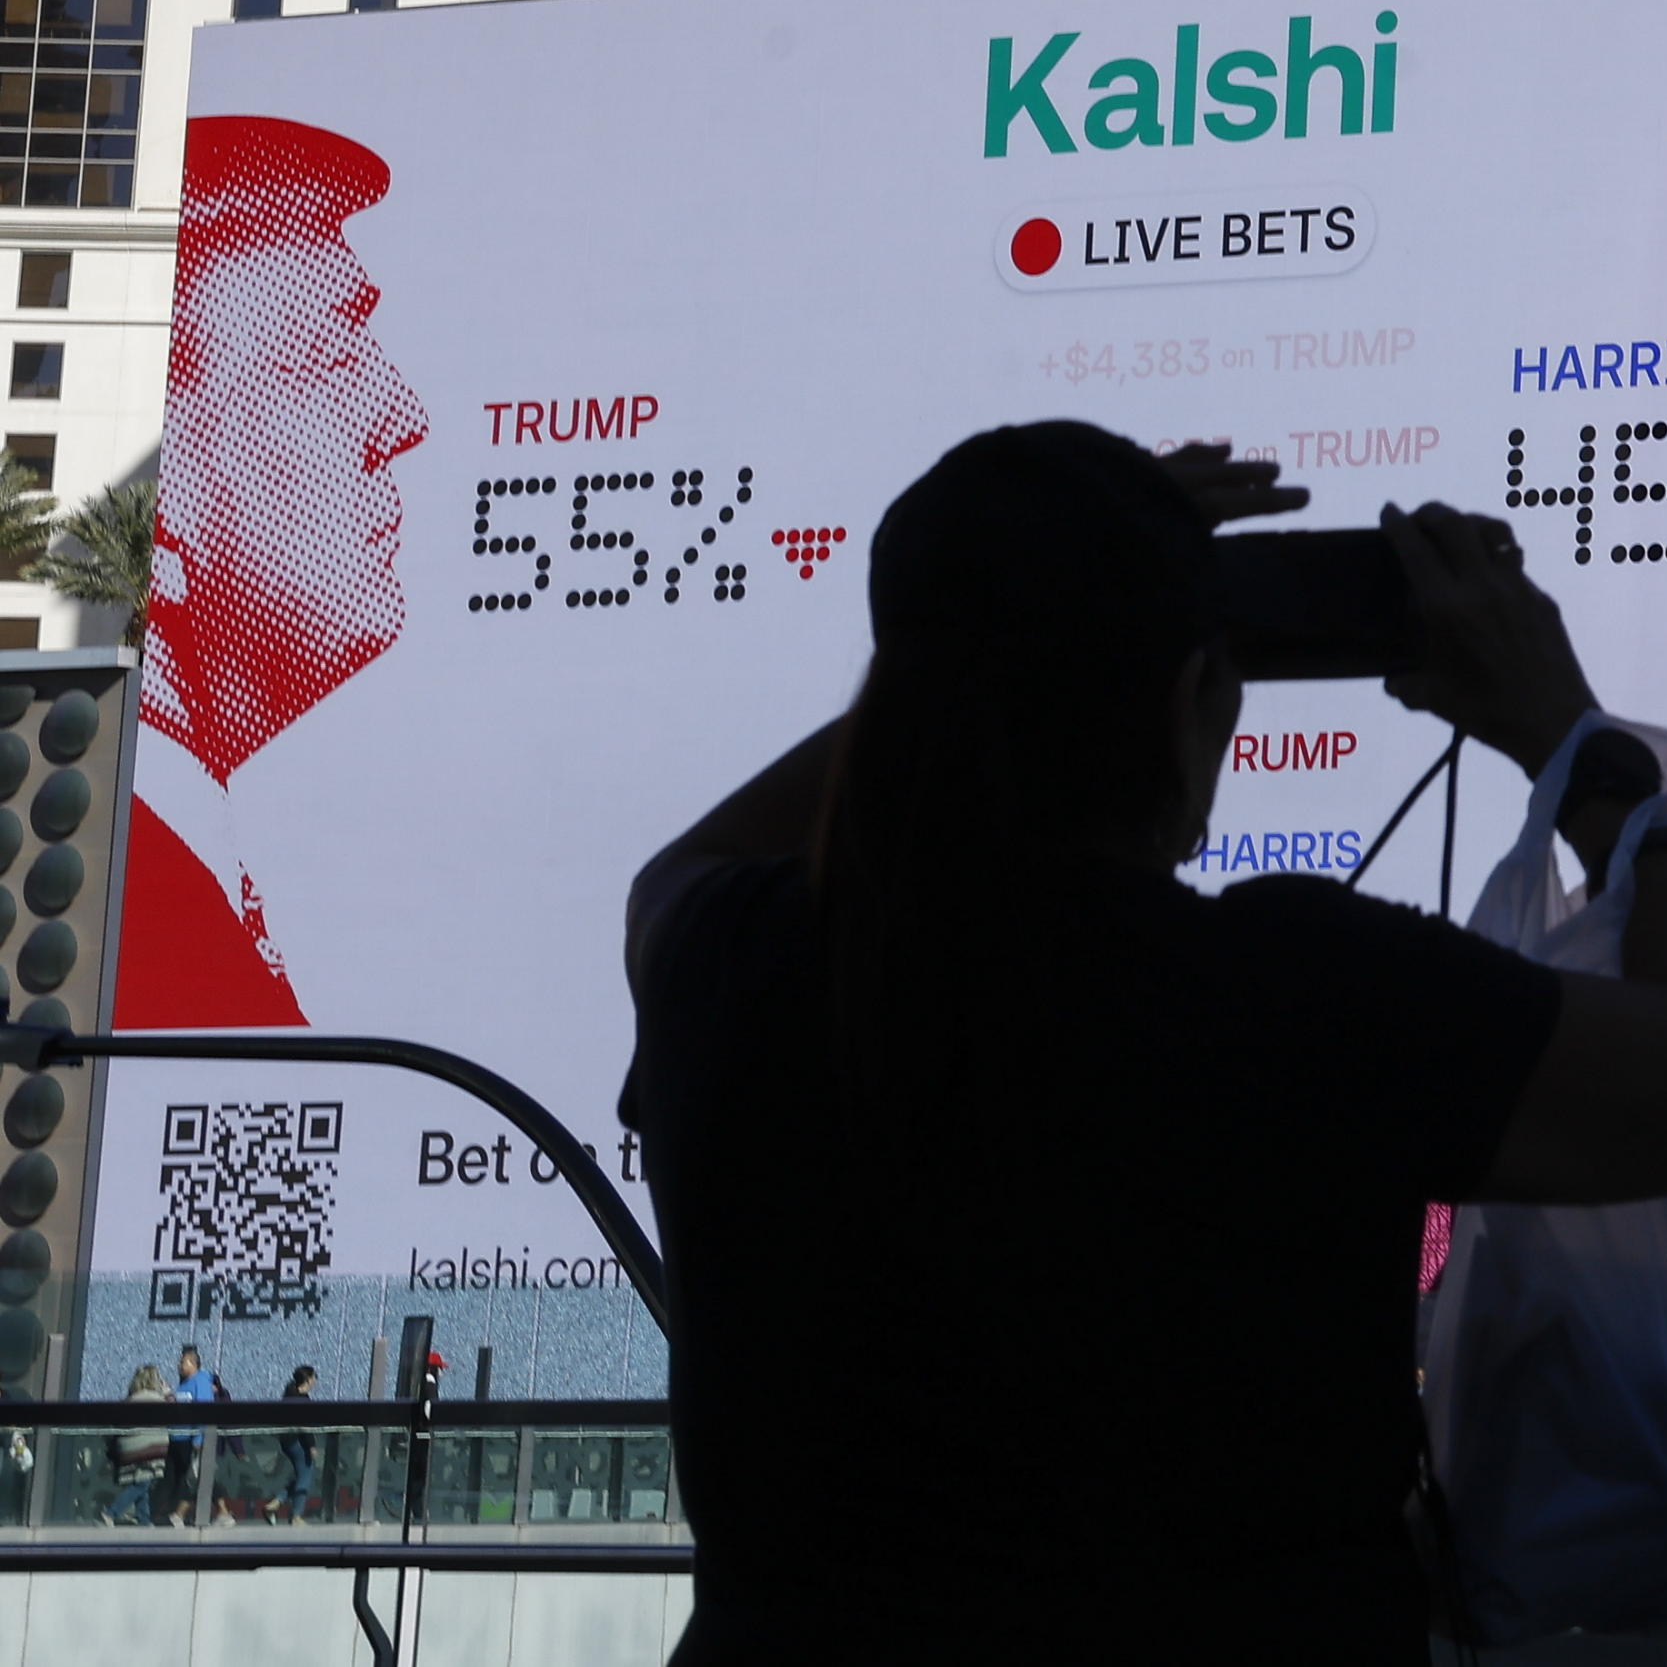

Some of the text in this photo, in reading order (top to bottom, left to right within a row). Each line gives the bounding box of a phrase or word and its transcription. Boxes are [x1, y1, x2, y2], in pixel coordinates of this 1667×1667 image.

[984, 10, 1398, 159] Kalshi
[1084, 206, 1356, 266] LIVE BETS
[1037, 328, 1416, 388] +$4,383 on TRUMP
[483, 395, 660, 446] TRUMP
[1288, 427, 1441, 469] TRUMP
[468, 466, 754, 613] 55%
[1232, 731, 1358, 773] RUMP
[1199, 830, 1362, 872] HARRIS
[418, 1130, 512, 1186] Bet
